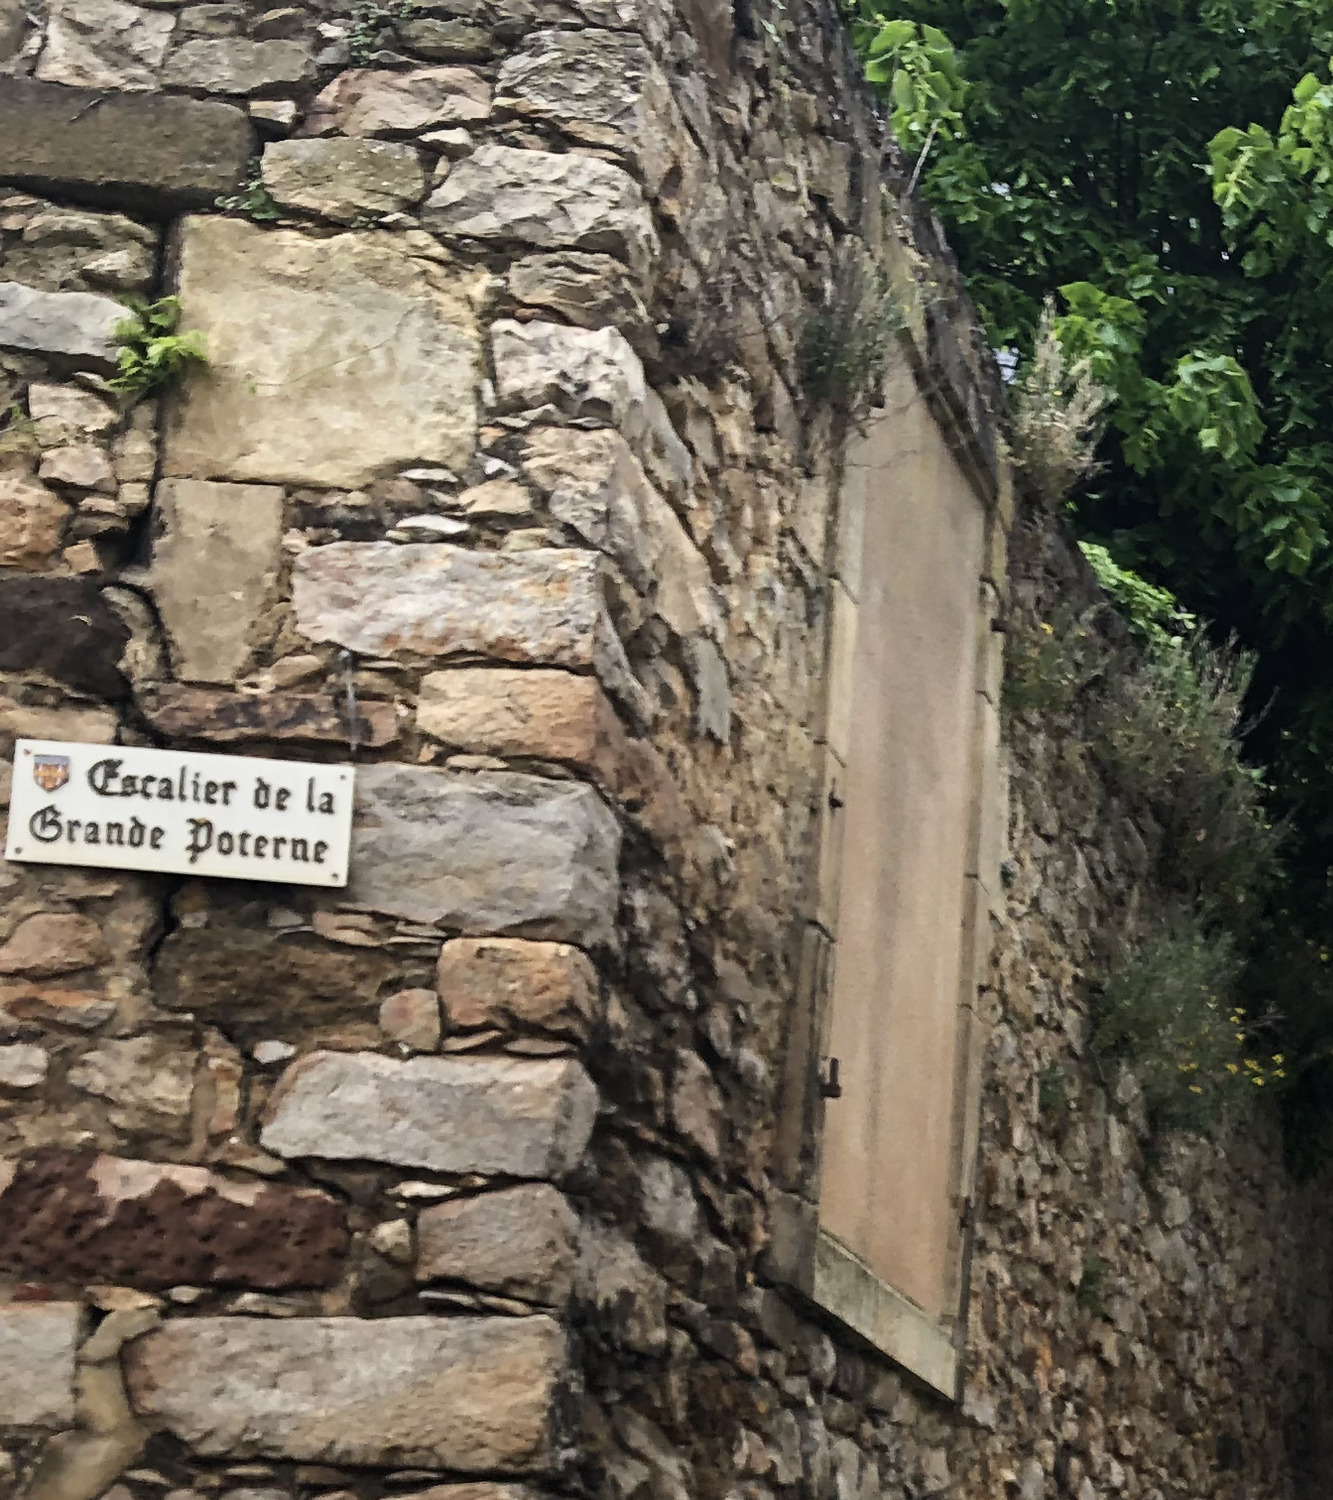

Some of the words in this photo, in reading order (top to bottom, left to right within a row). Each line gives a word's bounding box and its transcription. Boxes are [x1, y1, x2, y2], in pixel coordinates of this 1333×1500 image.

[87, 759, 236, 805] Escalier
[254, 777, 291, 811] de
[306, 776, 335, 814] la
[29, 804, 165, 849] Grande
[185, 818, 328, 864] Poterne
